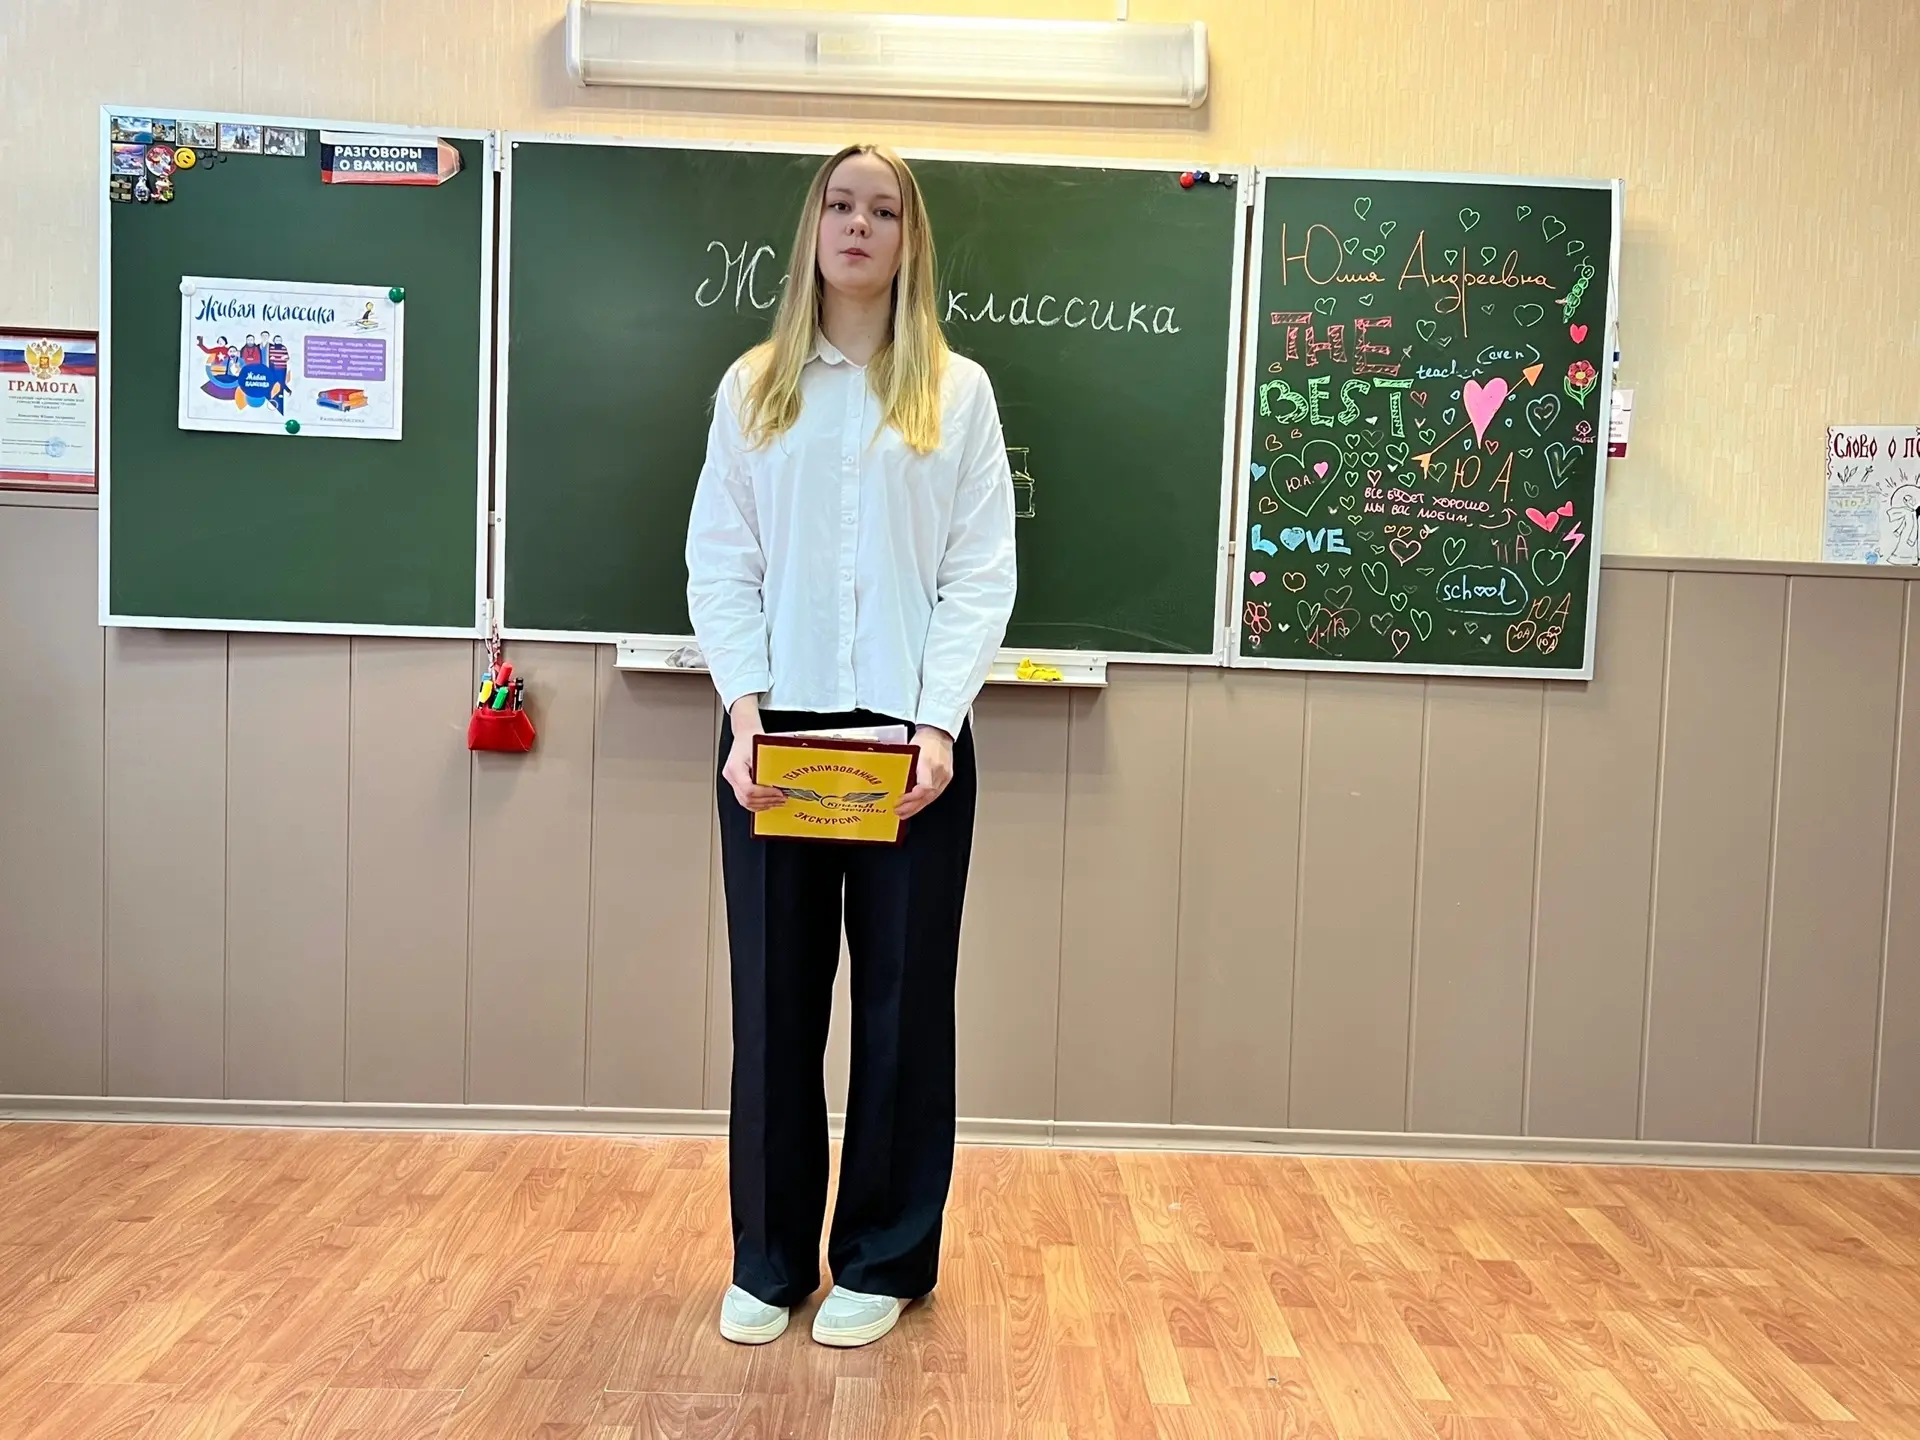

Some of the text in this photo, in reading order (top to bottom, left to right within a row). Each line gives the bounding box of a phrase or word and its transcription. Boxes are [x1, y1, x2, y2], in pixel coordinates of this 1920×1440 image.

[334, 146, 422, 159] РАЗГОВОРЫ
[340, 160, 418, 172] О ВАЖНОМ
[1283, 222, 1556, 338] Юлия Андреевна
[195, 295, 335, 324] Живая классика
[944, 289, 1182, 335] классика
[1271, 312, 1402, 376] THE
[8, 380, 79, 394] ГРАМОТА
[1259, 375, 1415, 438] BEST
[1251, 523, 1352, 557] LOVE
[1443, 575, 1517, 606] school
[782, 764, 883, 786] ТЕАТРАЛИЗОВАННАЯ
[794, 811, 862, 825] ЭКСКУРСИЯ
